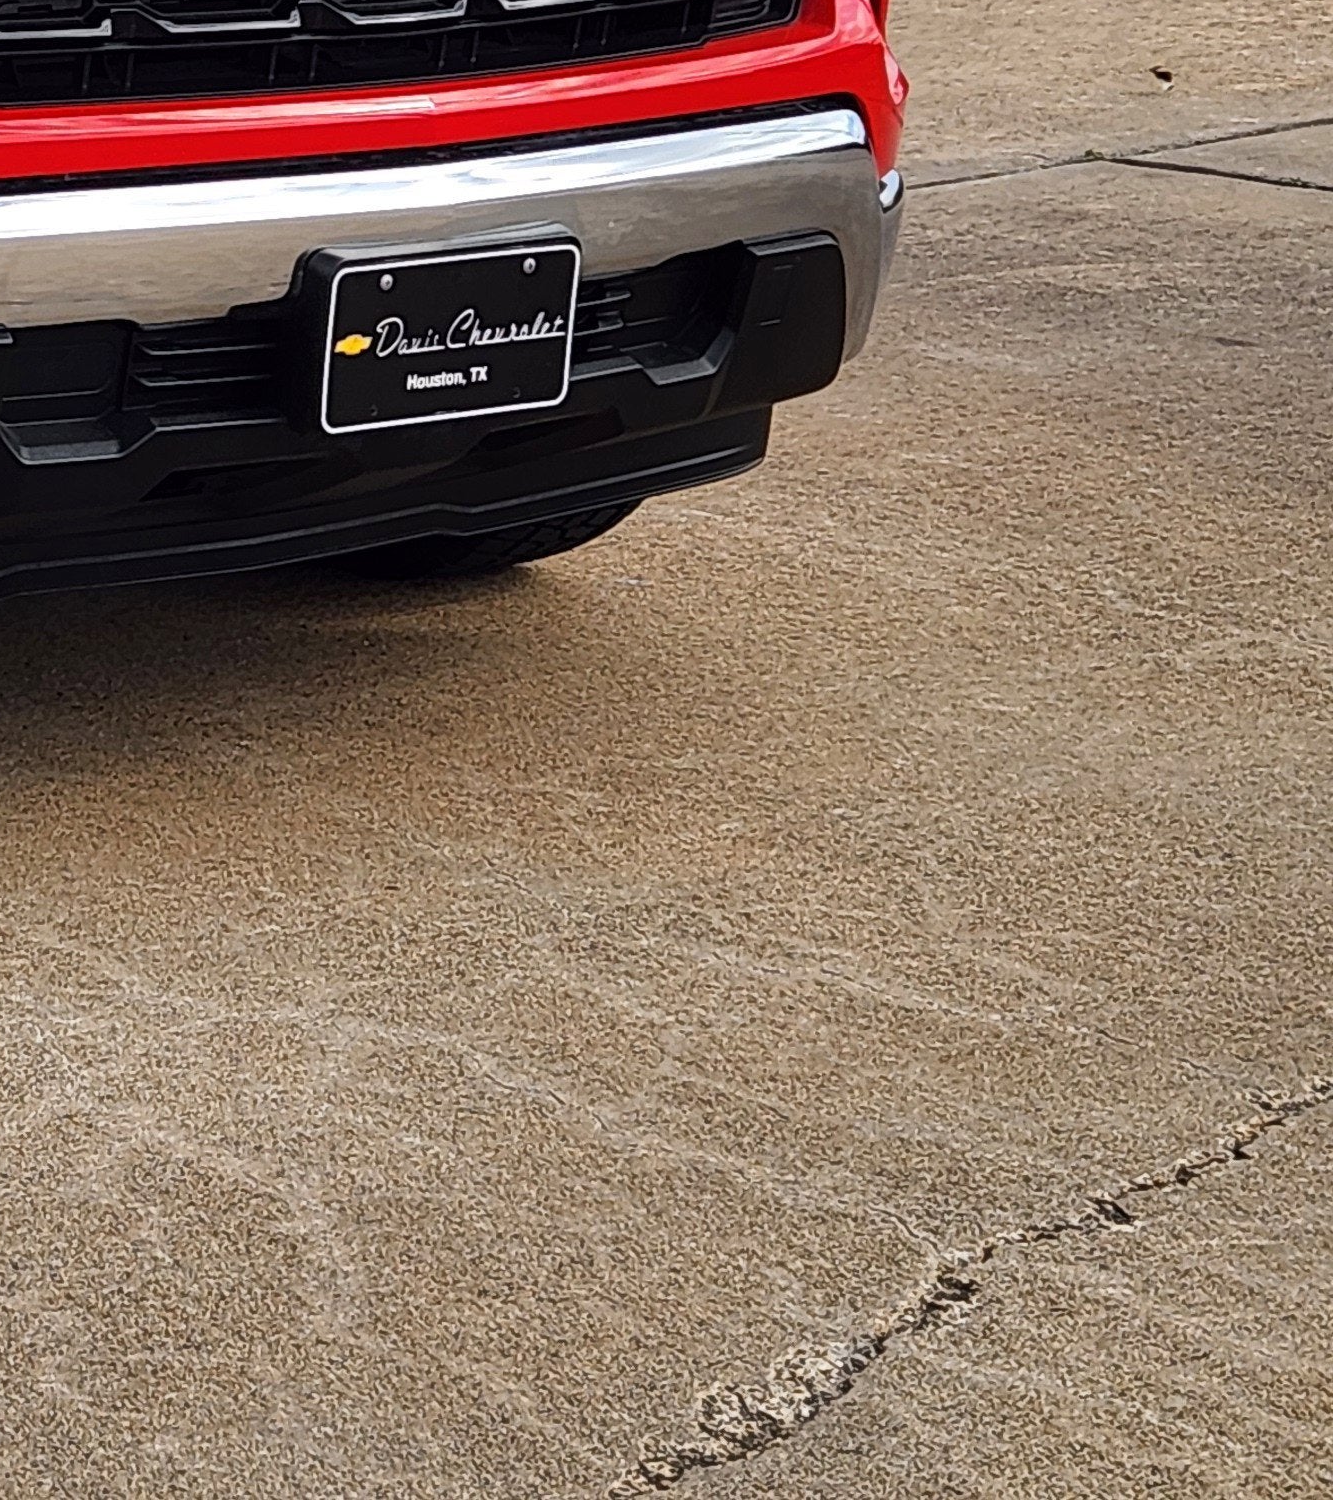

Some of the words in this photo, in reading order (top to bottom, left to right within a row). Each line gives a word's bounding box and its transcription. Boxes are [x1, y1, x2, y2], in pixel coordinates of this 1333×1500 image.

[375, 316, 446, 358] Davis
[446, 308, 566, 350] Chevrolet
[406, 371, 467, 390] Houston,
[470, 366, 489, 382] TX
